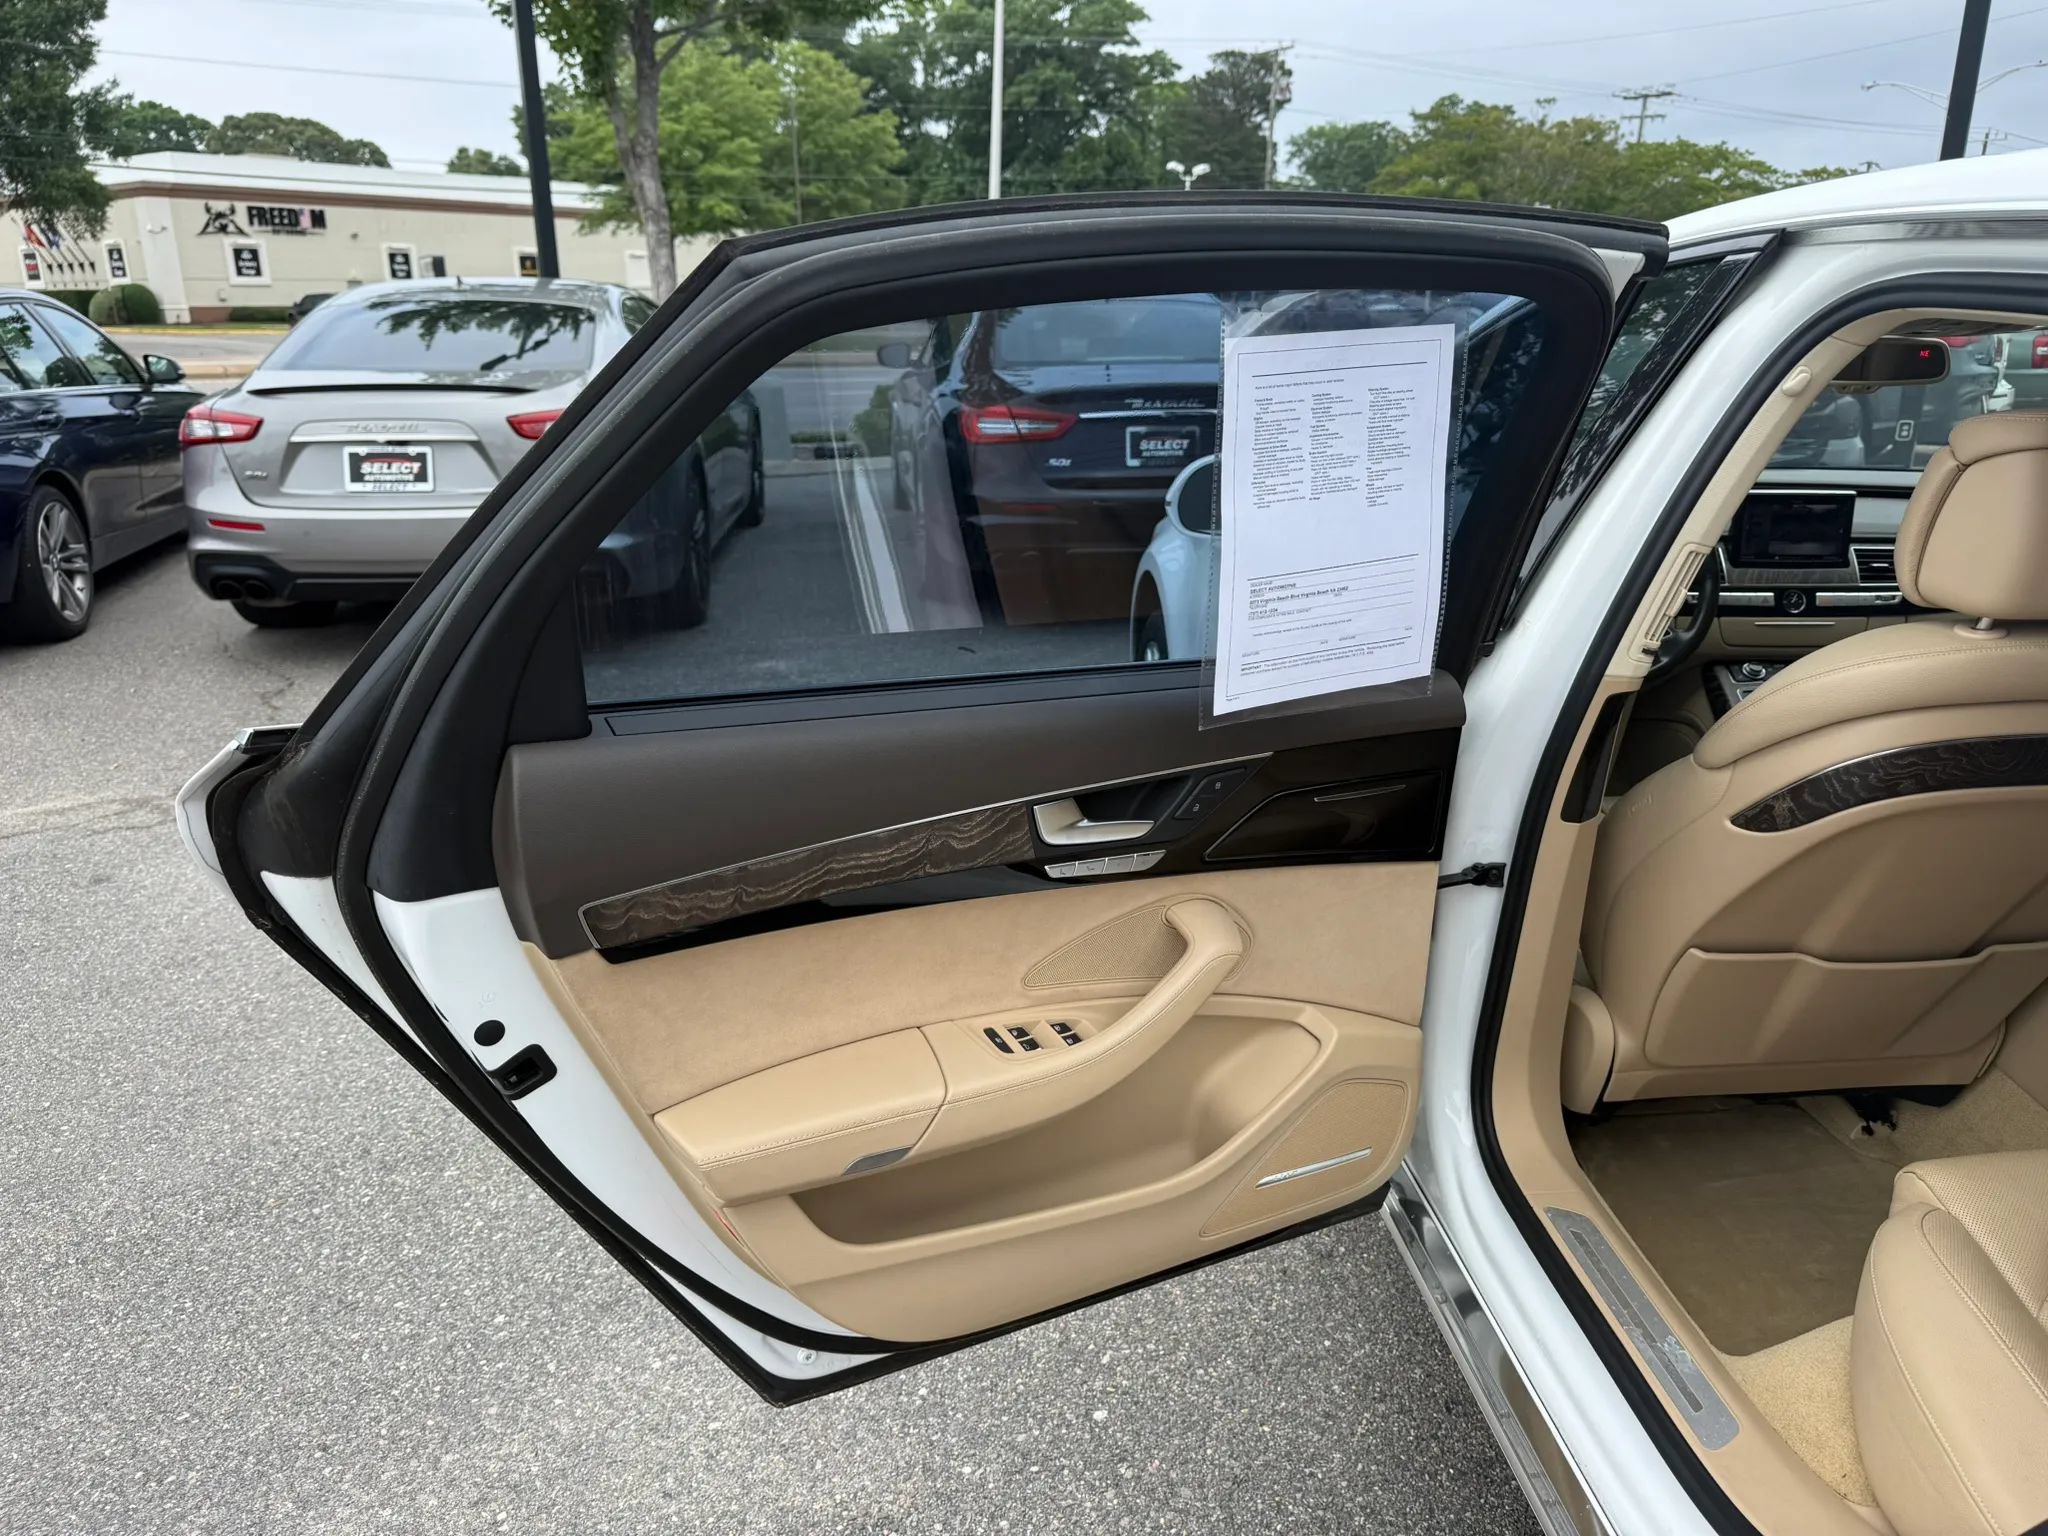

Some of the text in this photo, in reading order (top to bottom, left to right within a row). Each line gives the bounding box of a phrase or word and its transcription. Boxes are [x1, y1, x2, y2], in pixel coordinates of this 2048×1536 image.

[1139, 439, 1190, 450] SELECT
[360, 461, 421, 474] SELECT
[363, 473, 415, 482] AUTOMOTIVE
